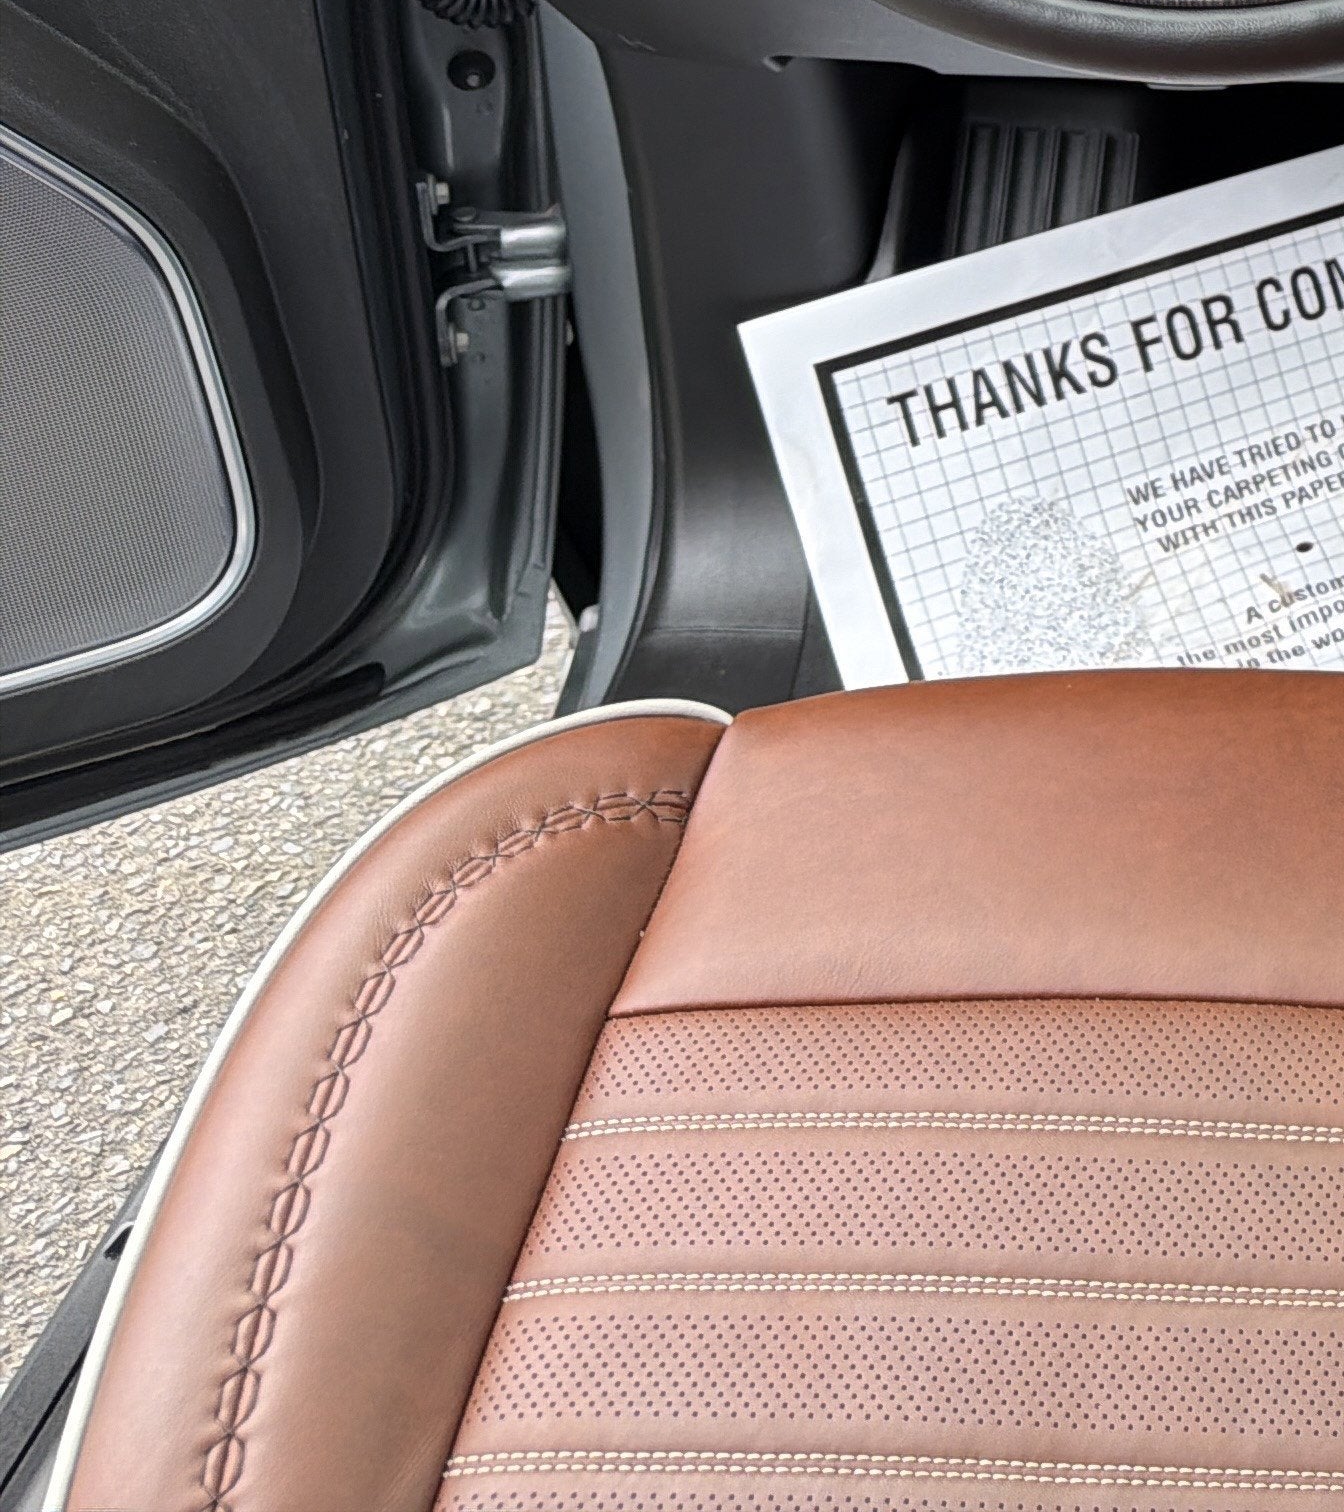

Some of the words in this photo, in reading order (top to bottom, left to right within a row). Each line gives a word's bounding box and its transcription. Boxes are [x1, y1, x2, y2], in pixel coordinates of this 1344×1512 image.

[887, 331, 1119, 449] THANKS
[1129, 293, 1245, 374] FOR
[1127, 477, 1167, 507] WE
[1170, 455, 1232, 492] HAVE
[1233, 430, 1303, 470] TRIED
[1304, 418, 1337, 445] TO
[1133, 496, 1201, 534] YOUR
[1206, 450, 1333, 510] CARPETING
[1156, 518, 1221, 554] WITH
[1223, 497, 1278, 530] THIS
[1246, 605, 1264, 625] A
[1176, 646, 1217, 668] the
[1223, 623, 1285, 656] most
[1266, 643, 1307, 664] the
